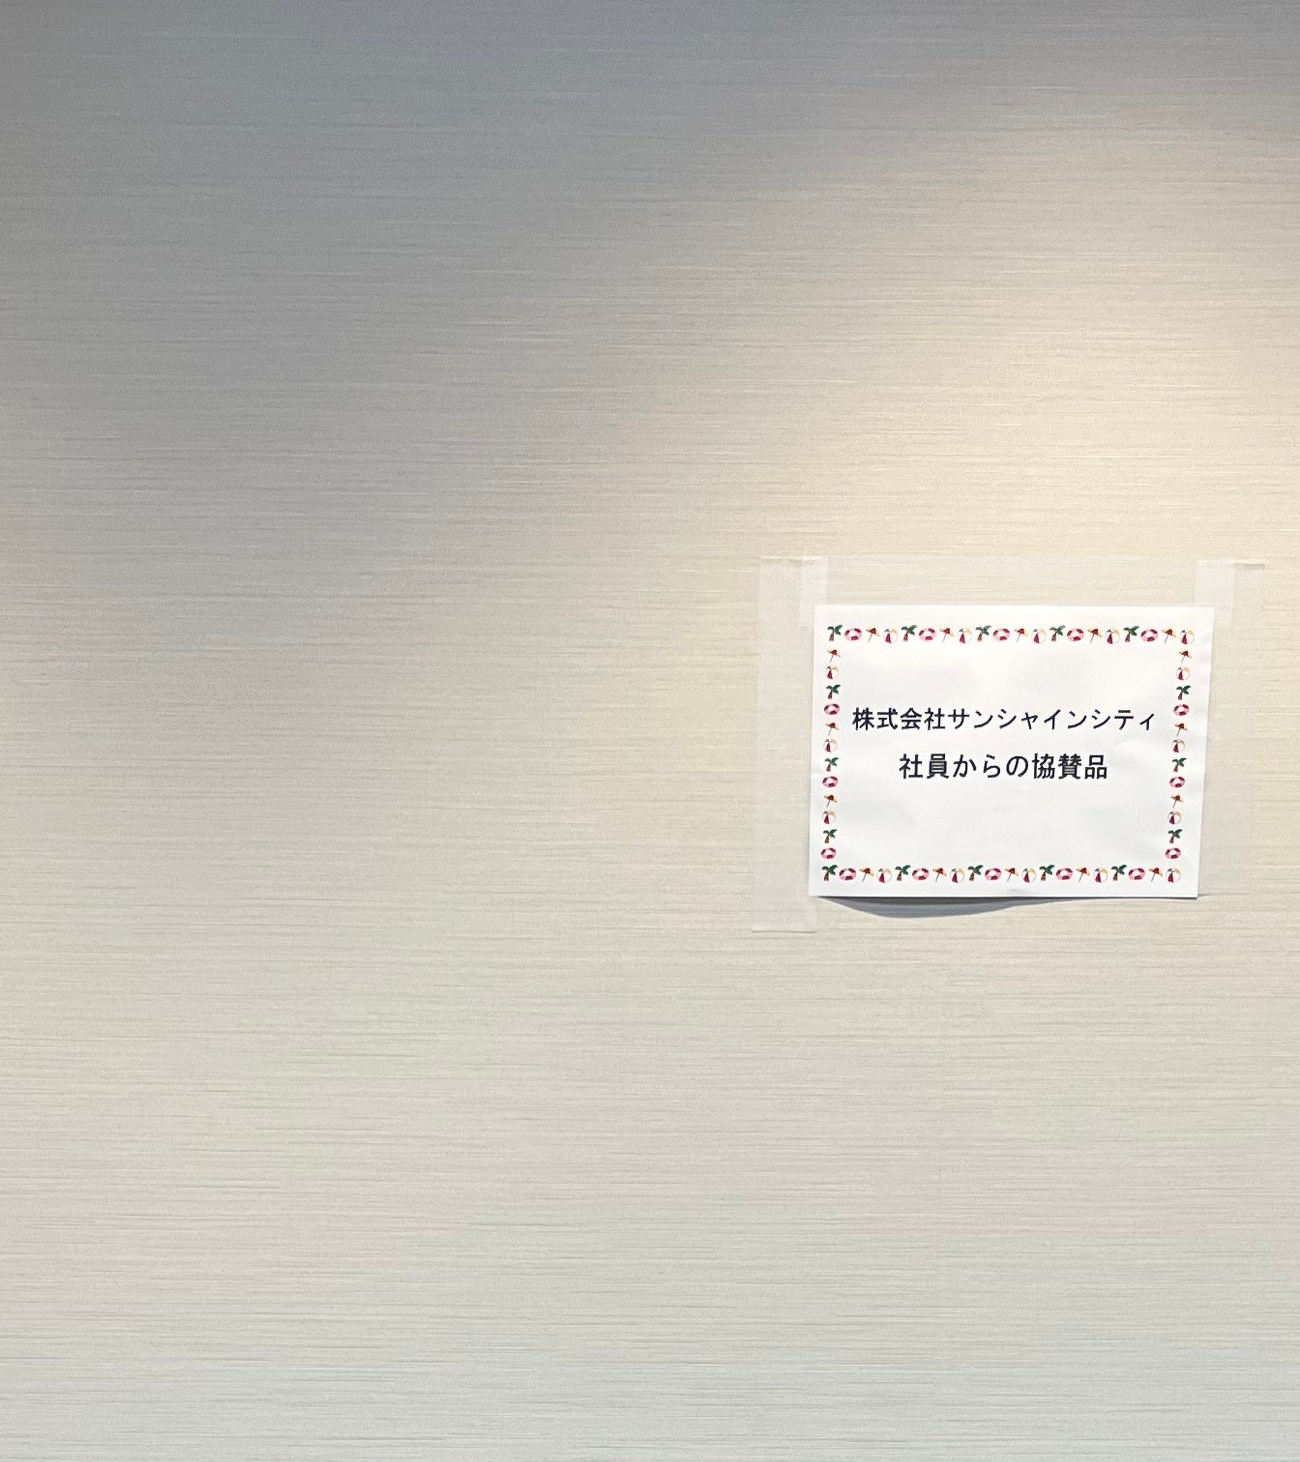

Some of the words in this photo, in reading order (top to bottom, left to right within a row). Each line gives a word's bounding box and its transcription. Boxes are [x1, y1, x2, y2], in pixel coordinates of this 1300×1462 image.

[852, 706, 1156, 731] 株式会社サンシャインシティ
[899, 753, 1108, 780] 社員からの協賛品
